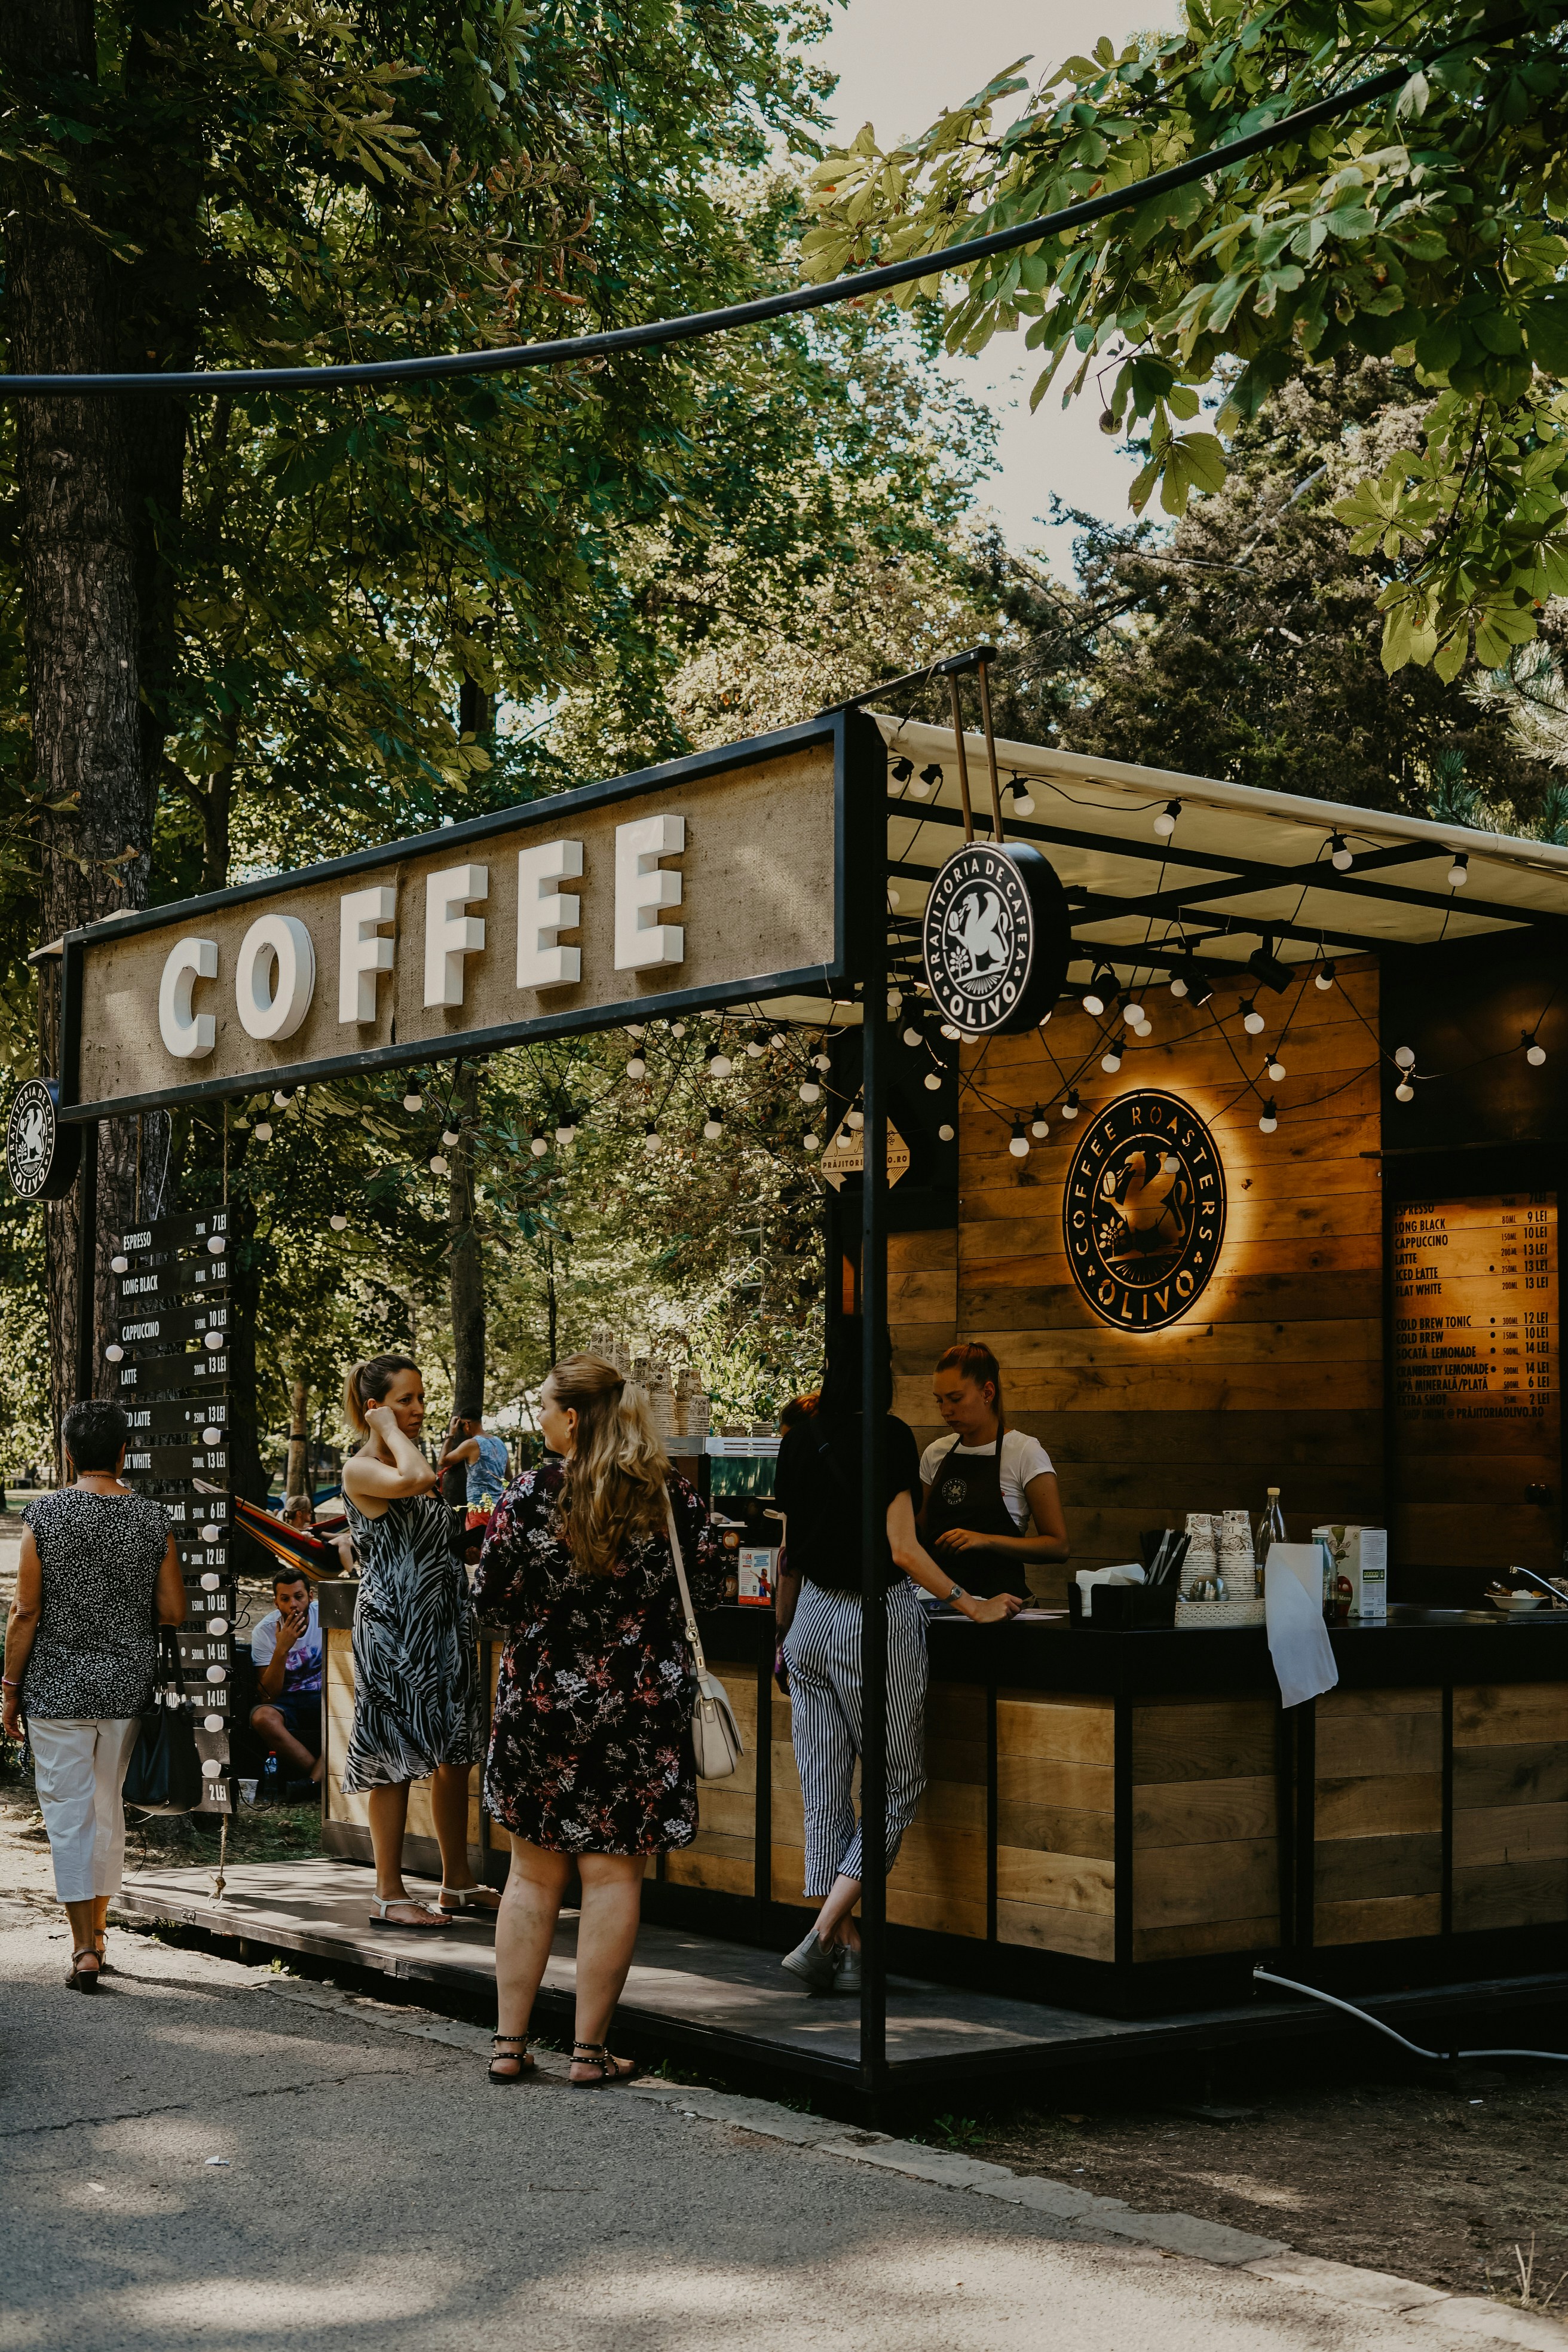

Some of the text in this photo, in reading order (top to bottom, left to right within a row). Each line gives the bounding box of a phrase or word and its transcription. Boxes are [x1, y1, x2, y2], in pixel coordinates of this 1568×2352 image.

[930, 858, 1027, 982] PRAJITORIA DE CAFEA
[158, 814, 685, 1059] COFFEE
[950, 981, 1016, 1025] OLIVO
[10, 1086, 36, 1162] PRAJITORIA
[38, 1088, 47, 1104] DE
[16, 1167, 45, 1193] OLIVO
[1074, 1106, 1215, 1255] COFFEE ROASTERS
[1395, 1202, 1434, 1216] ESPRESSO
[123, 1231, 151, 1251] ESPRESSO
[213, 1215, 218, 1231] 7
[218, 1214, 226, 1230] LEI
[1395, 1211, 1547, 1233] LONG BLACK 80ML 9 LEI
[1395, 1226, 1547, 1249] CAPPUCCINO 150ML 10 LEI
[1395, 1244, 1548, 1265] LATTE 200ML 13 LEI
[122, 1278, 139, 1296] LONG
[140, 1275, 158, 1293] BLACK
[212, 1263, 216, 1279] 9
[218, 1261, 226, 1278] LEI
[1396, 1269, 1413, 1281] ICED
[1416, 1267, 1438, 1279] LATTE
[1524, 1260, 1535, 1272] 13
[1536, 1260, 1548, 1271] LEI
[1098, 1270, 1194, 1320] OLIVO
[1395, 1276, 1548, 1297] FLAT WHITE 200ML 13 LEI
[122, 1321, 160, 1341] CAPPUCCINO
[209, 1310, 216, 1327] 10
[218, 1309, 226, 1326] LEI
[1396, 1318, 1417, 1331] COLD
[1420, 1317, 1443, 1329] BREW
[1446, 1315, 1471, 1327] TONIC
[1524, 1312, 1535, 1324] 12
[1536, 1312, 1548, 1324] LEI
[1396, 1333, 1417, 1345] COLD
[1420, 1331, 1444, 1343] BREW
[1525, 1327, 1535, 1339] 10
[1536, 1327, 1548, 1338] LEI
[1396, 1345, 1428, 1359] SOCATĂ
[1431, 1346, 1476, 1359] LEMONADE
[1525, 1342, 1535, 1353] 14
[1537, 1342, 1549, 1353] LEI
[121, 1368, 137, 1385] LATTE
[209, 1356, 216, 1373] 13
[217, 1356, 226, 1372] LEI
[1396, 1365, 1442, 1377] CRANBERRY
[1445, 1363, 1489, 1376] LEMONADE
[1526, 1362, 1535, 1374] 14
[1537, 1362, 1549, 1373] LEI
[1396, 1378, 1413, 1392] APĂ
[1529, 1377, 1534, 1388] 6
[1538, 1376, 1549, 1388] LEI
[1397, 1394, 1422, 1407] EXTRA
[1425, 1394, 1447, 1405] SHOT
[1530, 1393, 1535, 1404] 2
[1538, 1393, 1549, 1404] LEI
[134, 1411, 151, 1427] LATTE
[208, 1406, 216, 1422] 13
[216, 1405, 225, 1422] LEI
[131, 1453, 151, 1469] WHITE
[207, 1452, 215, 1468] 13
[216, 1451, 226, 1468] LEI
[210, 1503, 215, 1519] 6
[216, 1502, 226, 1518] LEI
[206, 1549, 215, 1564] 12
[216, 1548, 225, 1564] LEI
[207, 1595, 216, 1611] 10
[216, 1594, 226, 1611] LEI
[207, 1643, 216, 1659] 14
[217, 1644, 227, 1660] LEI
[207, 1690, 216, 1707] 14
[216, 1689, 226, 1706] LEI
[209, 1784, 226, 1801] 2 LEI
